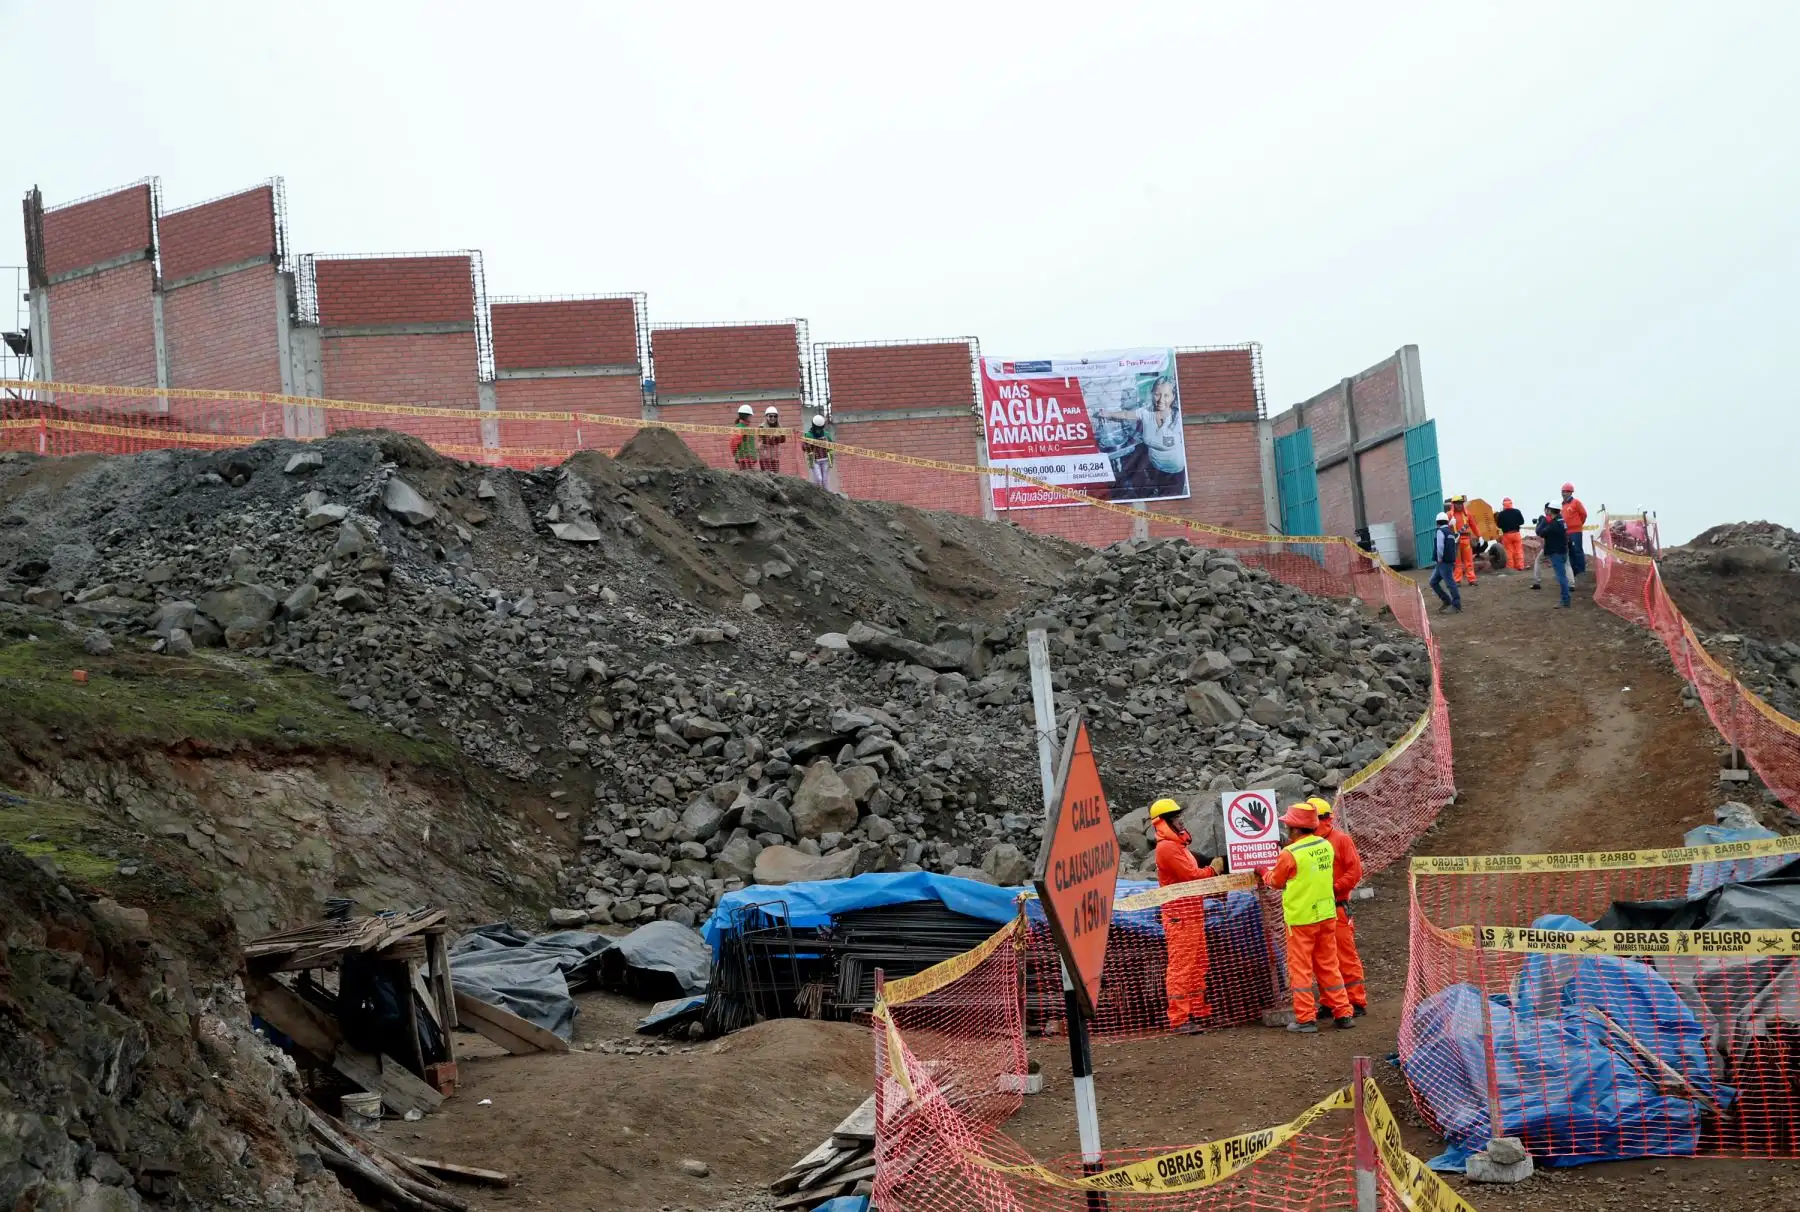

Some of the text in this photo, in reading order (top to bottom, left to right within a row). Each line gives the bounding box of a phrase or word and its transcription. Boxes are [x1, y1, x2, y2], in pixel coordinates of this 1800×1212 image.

[999, 382, 1030, 399] MÁS
[989, 398, 1064, 426] AGUA
[992, 423, 1088, 444] AMANCAES
[1078, 462, 1104, 472] 46,284
[1071, 796, 1101, 832] CALLE
[1231, 843, 1277, 853] PROHIBIDO
[1243, 851, 1278, 860] INGRESO
[1055, 839, 1114, 892] CLAUSURADA
[1073, 907, 1080, 939] A
[1082, 888, 1099, 935] 150
[1519, 929, 1575, 943] PELIGRO
[1613, 932, 1669, 944] OBRAS
[1694, 931, 1751, 944] PELIGRO
[1224, 1131, 1274, 1161] PELIGRO
[1157, 1150, 1204, 1177] OBRAS
